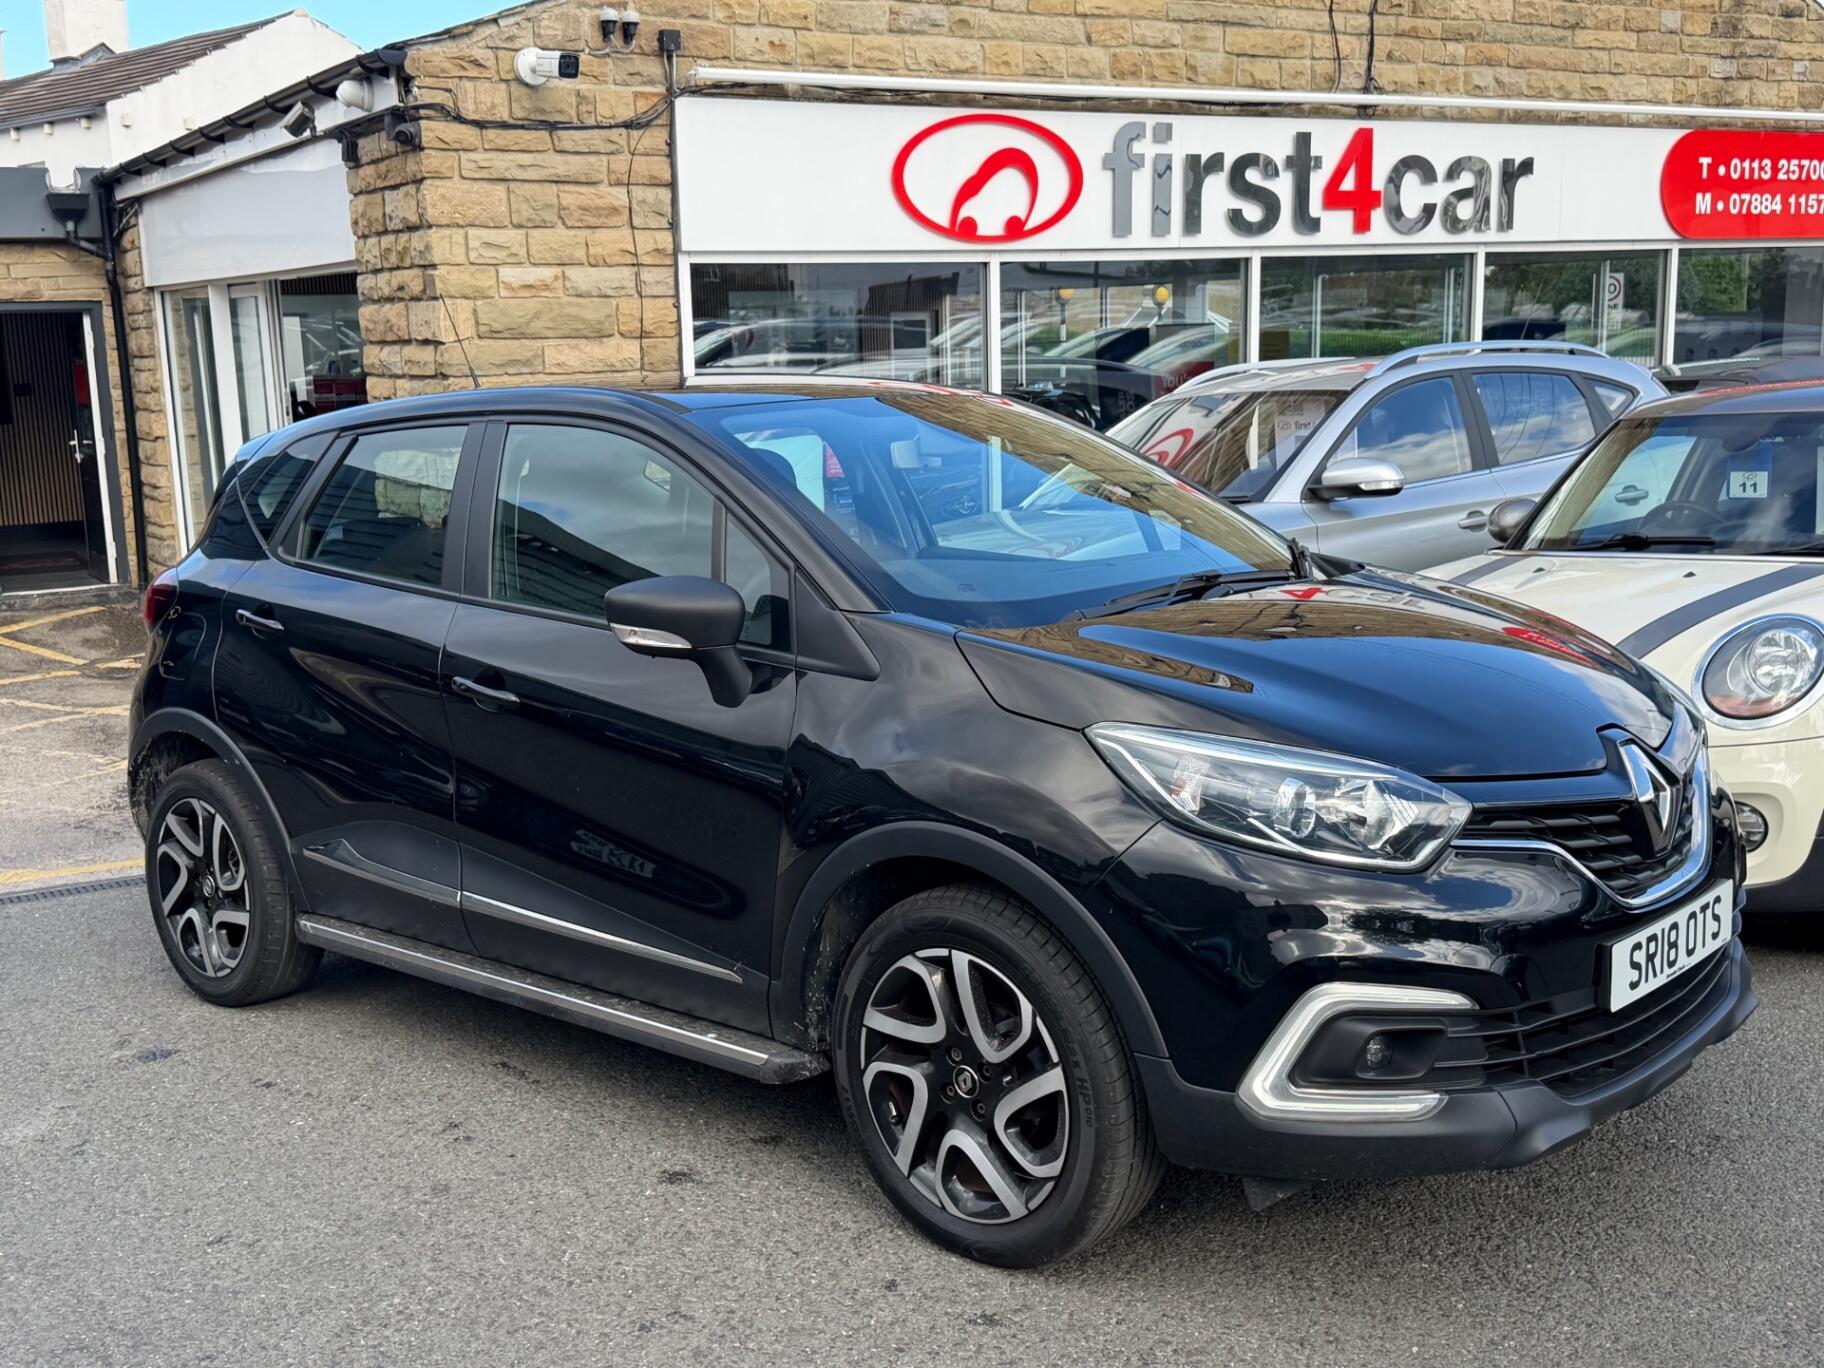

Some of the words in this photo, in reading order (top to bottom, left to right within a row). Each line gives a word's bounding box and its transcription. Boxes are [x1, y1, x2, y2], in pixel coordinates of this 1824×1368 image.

[1103, 121, 1534, 237] first4car
[1698, 157, 1712, 179] T
[1730, 158, 1772, 180] 0113
[1695, 192, 1712, 214] M
[1729, 193, 1782, 214] 07884
[1739, 481, 1758, 494] 11
[1628, 920, 1680, 991] SR18
[1685, 894, 1722, 958] OTS
